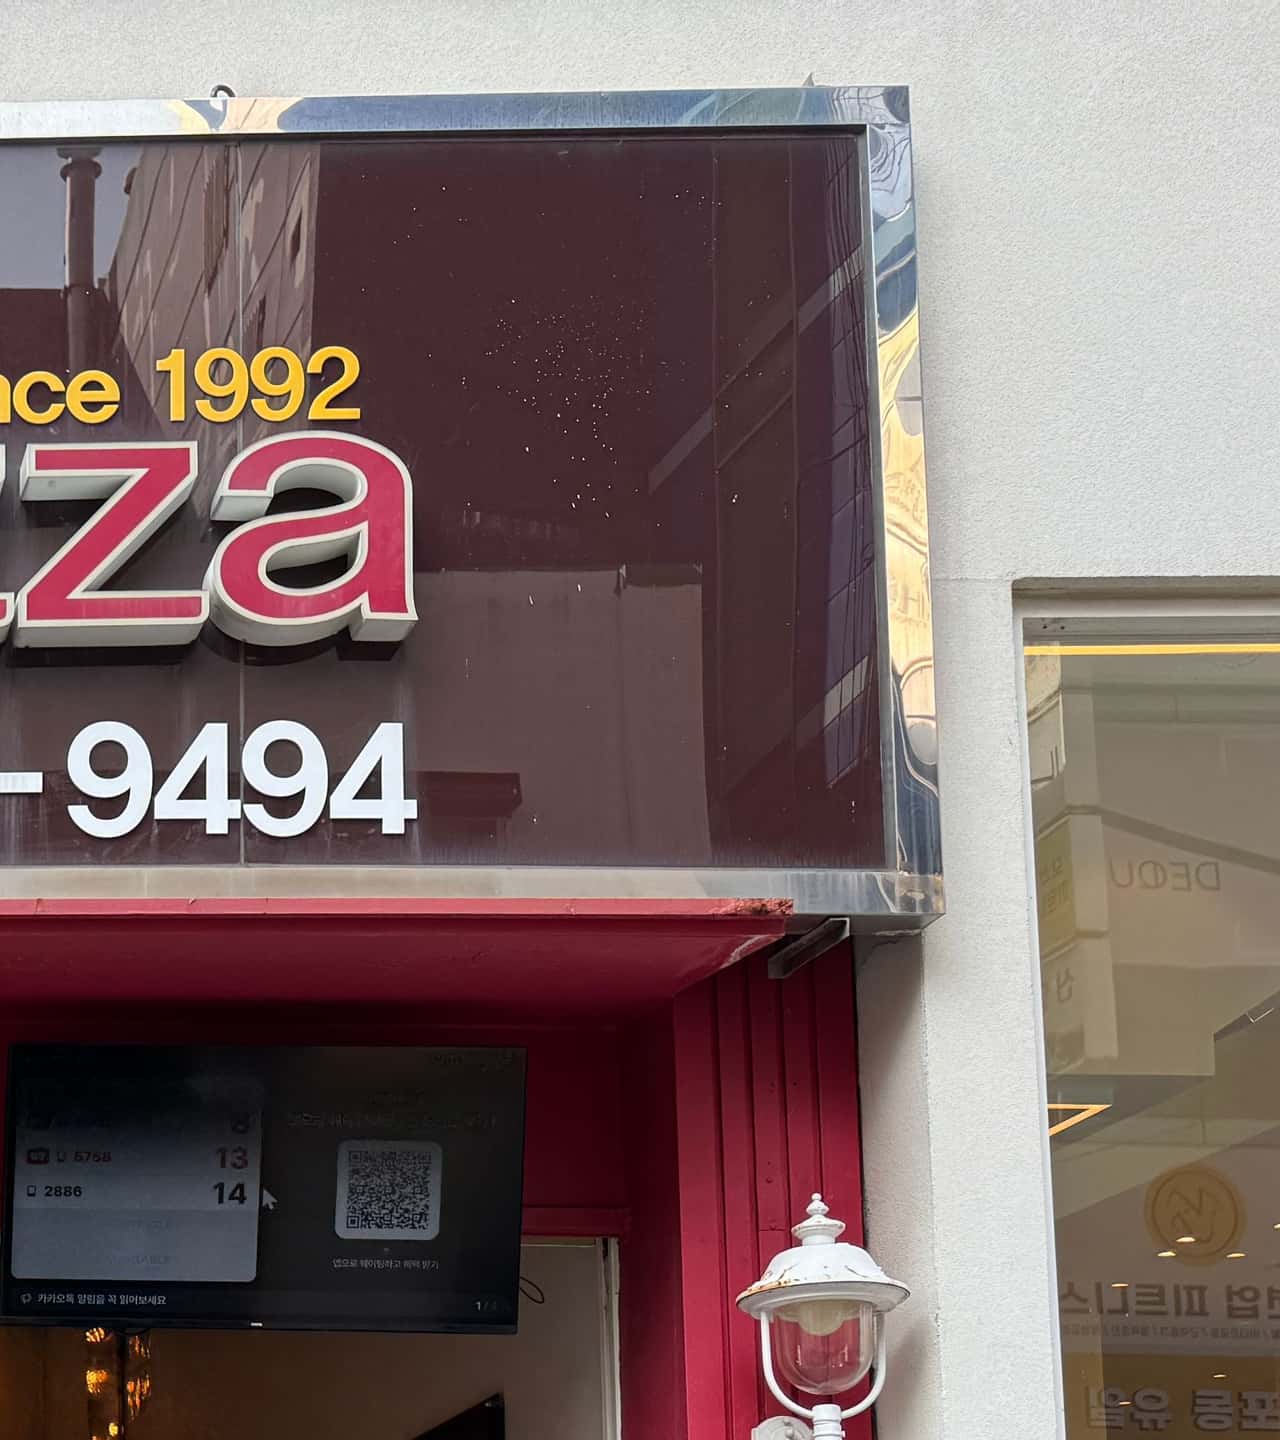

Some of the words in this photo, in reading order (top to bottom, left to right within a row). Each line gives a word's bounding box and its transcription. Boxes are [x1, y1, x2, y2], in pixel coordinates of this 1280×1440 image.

[156, 346, 361, 423] 1992
[216, 1147, 249, 1171] 13
[212, 1181, 248, 1206] 14
